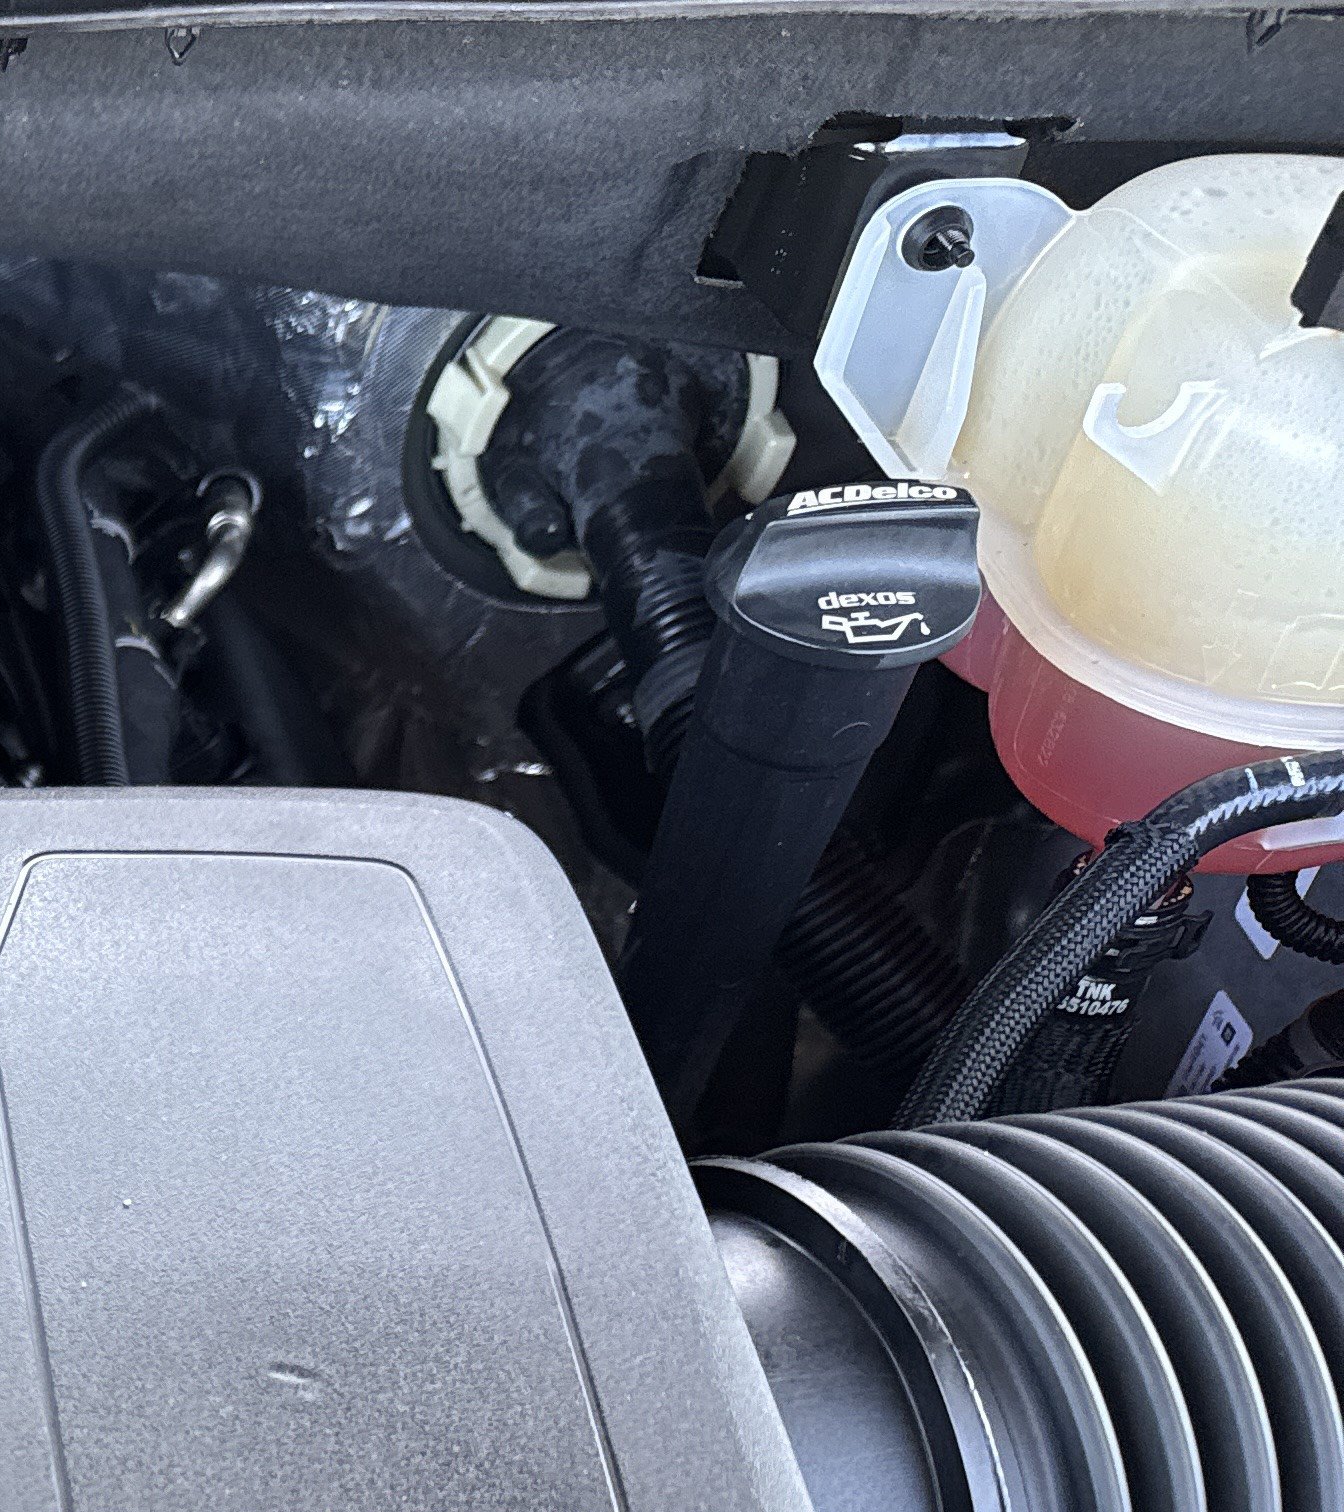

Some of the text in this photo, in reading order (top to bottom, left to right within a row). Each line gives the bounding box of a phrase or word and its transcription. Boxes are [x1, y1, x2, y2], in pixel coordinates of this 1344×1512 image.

[787, 482, 957, 510] ACDelco
[818, 591, 916, 610] dexos
[1075, 980, 1116, 1001] TNK
